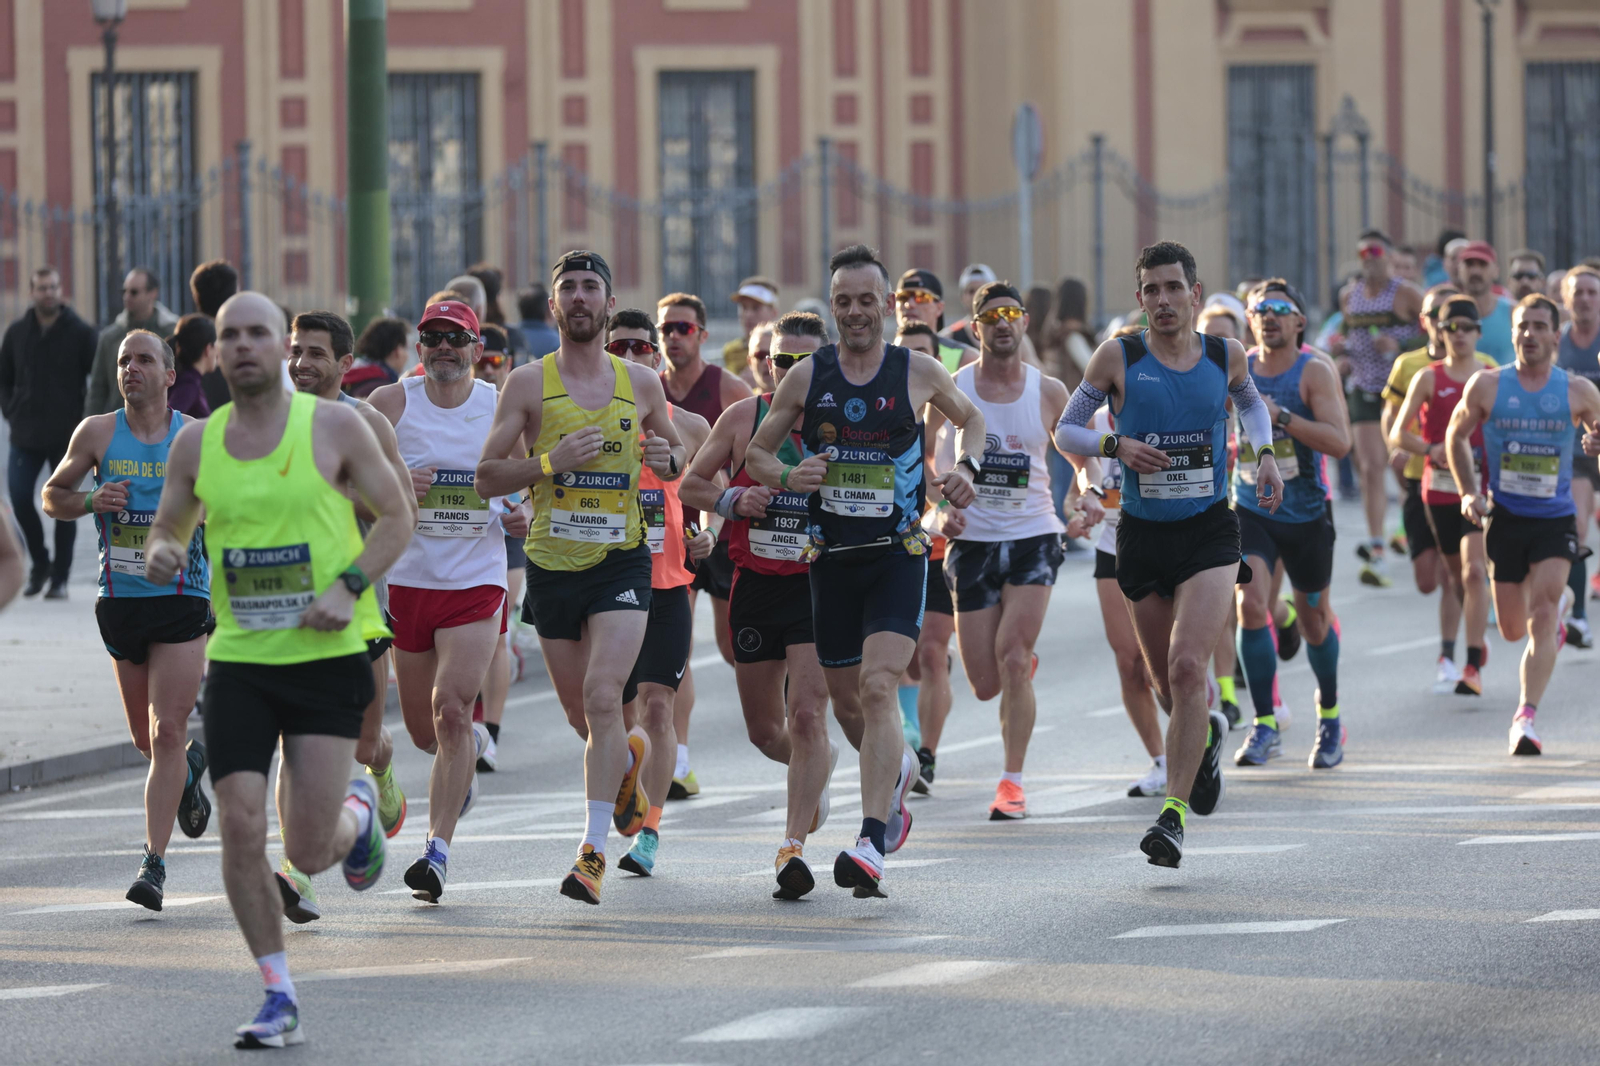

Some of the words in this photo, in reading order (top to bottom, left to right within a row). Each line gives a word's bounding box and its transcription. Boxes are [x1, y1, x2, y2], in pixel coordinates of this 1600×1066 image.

[842, 426, 890, 441] Botanik
[1163, 433, 1204, 444] ZURICH
[1521, 445, 1556, 455] ZURICH
[987, 456, 1024, 466] ZURICH
[1171, 456, 1190, 467] 978
[109, 460, 139, 476] PINEDA
[142, 462, 153, 478] DE
[440, 474, 474, 483] ZURIC
[578, 475, 621, 486] ZURICH
[842, 472, 867, 484] 1481
[641, 493, 657, 501] ICH
[833, 490, 842, 499] EL
[844, 490, 876, 500] CHAMA
[979, 487, 1011, 497] SOLARES
[441, 494, 465, 505] 1192
[580, 497, 600, 508] 663
[776, 495, 808, 507] ZURIC
[132, 514, 155, 523] ZUR
[434, 511, 470, 521] FRANCIS
[775, 517, 800, 529] 1937
[771, 534, 799, 545] ANGEL
[248, 548, 300, 564] ZURICH
[615, 596, 639, 606] adidas
